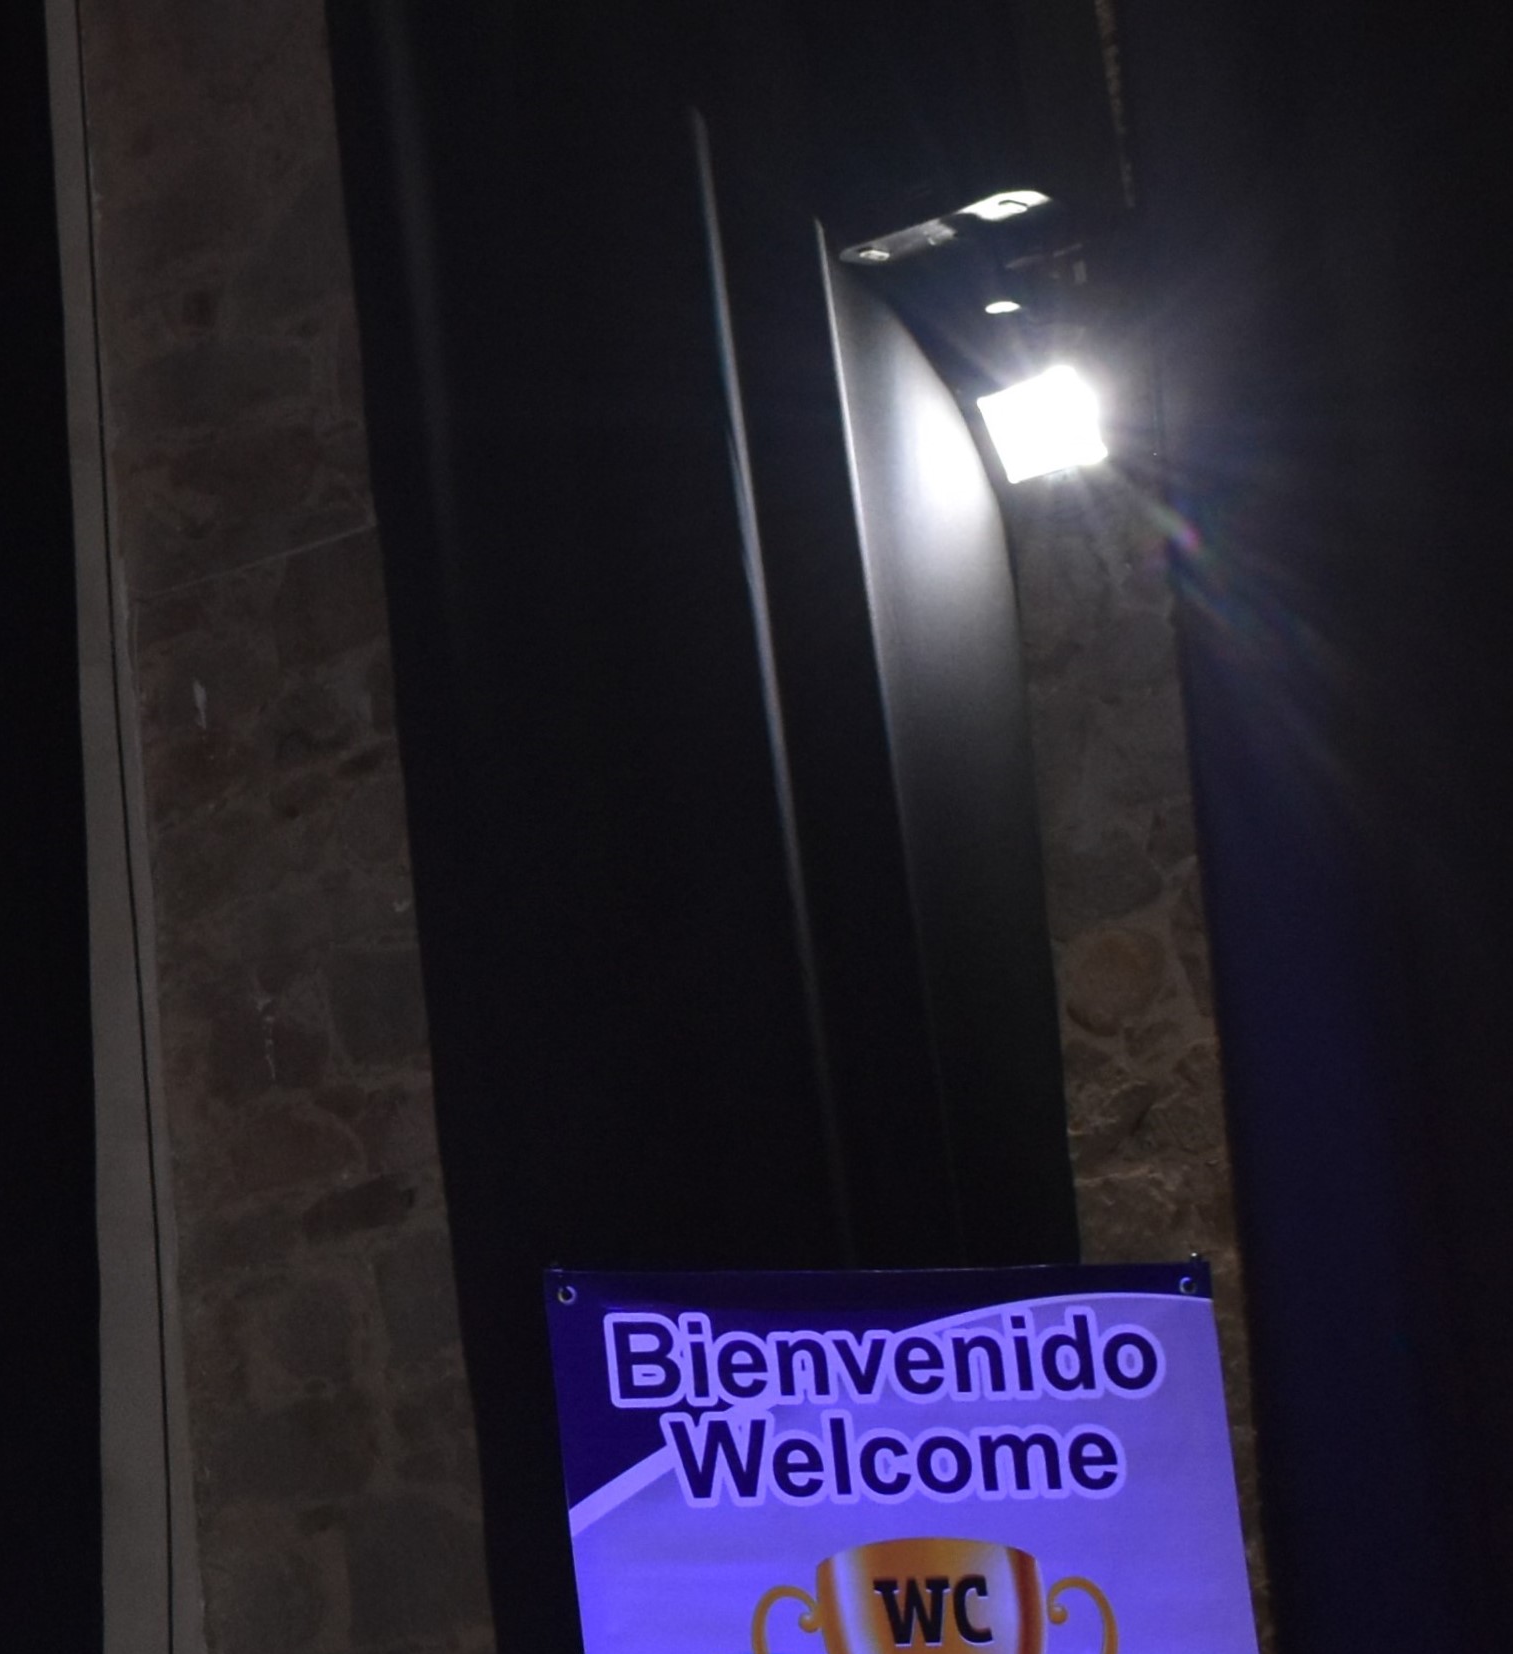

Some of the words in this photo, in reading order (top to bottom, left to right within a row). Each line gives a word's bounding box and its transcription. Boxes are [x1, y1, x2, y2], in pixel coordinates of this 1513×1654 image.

[610, 1314, 1160, 1402] Bienvenido
[668, 1416, 1120, 1500] Welcome
[873, 1574, 994, 1647] WC
